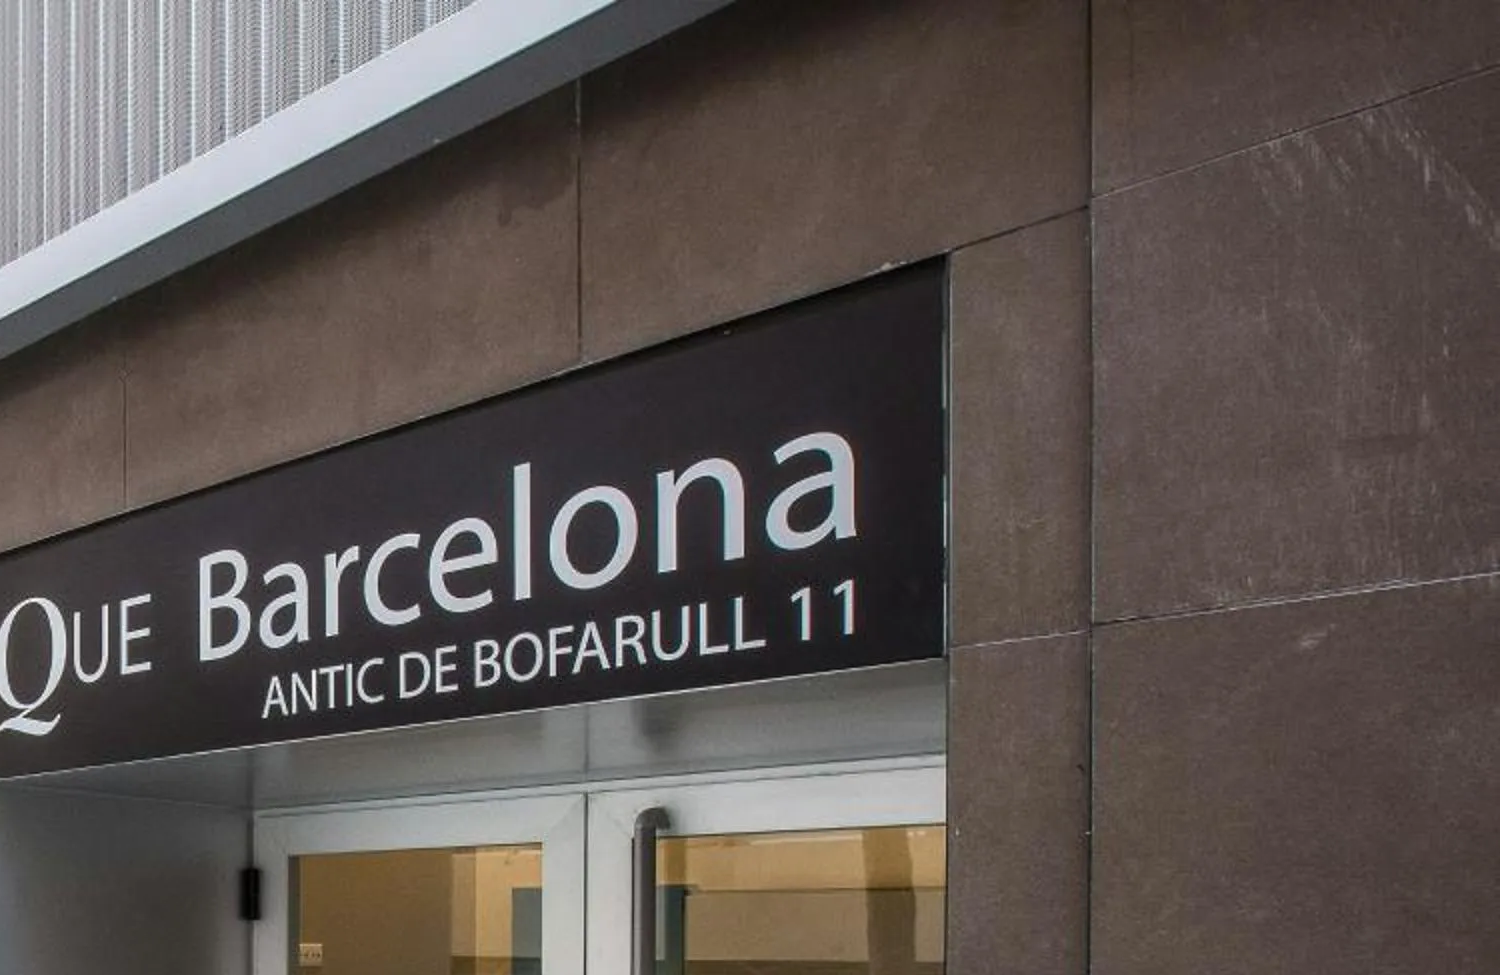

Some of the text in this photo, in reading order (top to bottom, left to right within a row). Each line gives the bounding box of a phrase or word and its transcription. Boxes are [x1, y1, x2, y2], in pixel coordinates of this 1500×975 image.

[199, 431, 858, 662] Barcelona
[261, 579, 855, 719] ANTIC DE BOFARULL 11
